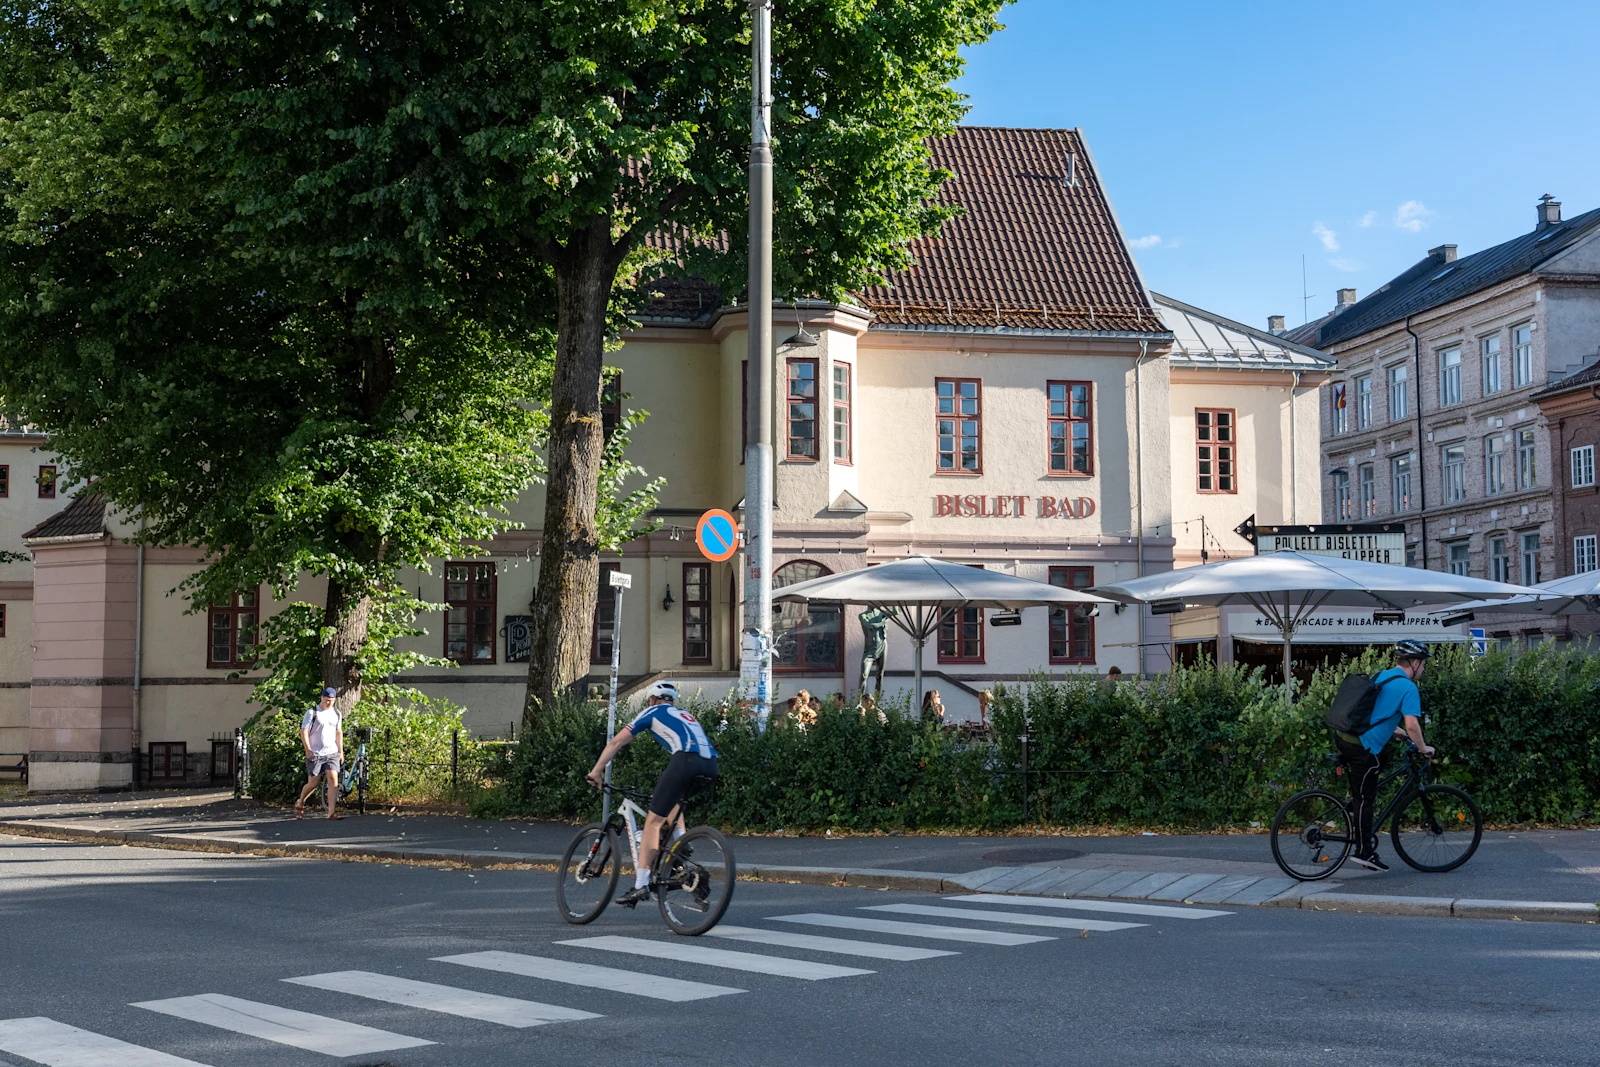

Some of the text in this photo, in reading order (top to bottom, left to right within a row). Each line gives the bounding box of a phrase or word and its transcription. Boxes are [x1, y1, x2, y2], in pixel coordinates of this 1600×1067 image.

[936, 494, 1096, 518] BISLET BAD
[1326, 535, 1378, 550] BISLETT!
[1346, 617, 1384, 626] BILBANE
[1397, 617, 1431, 626] FLIPPER
